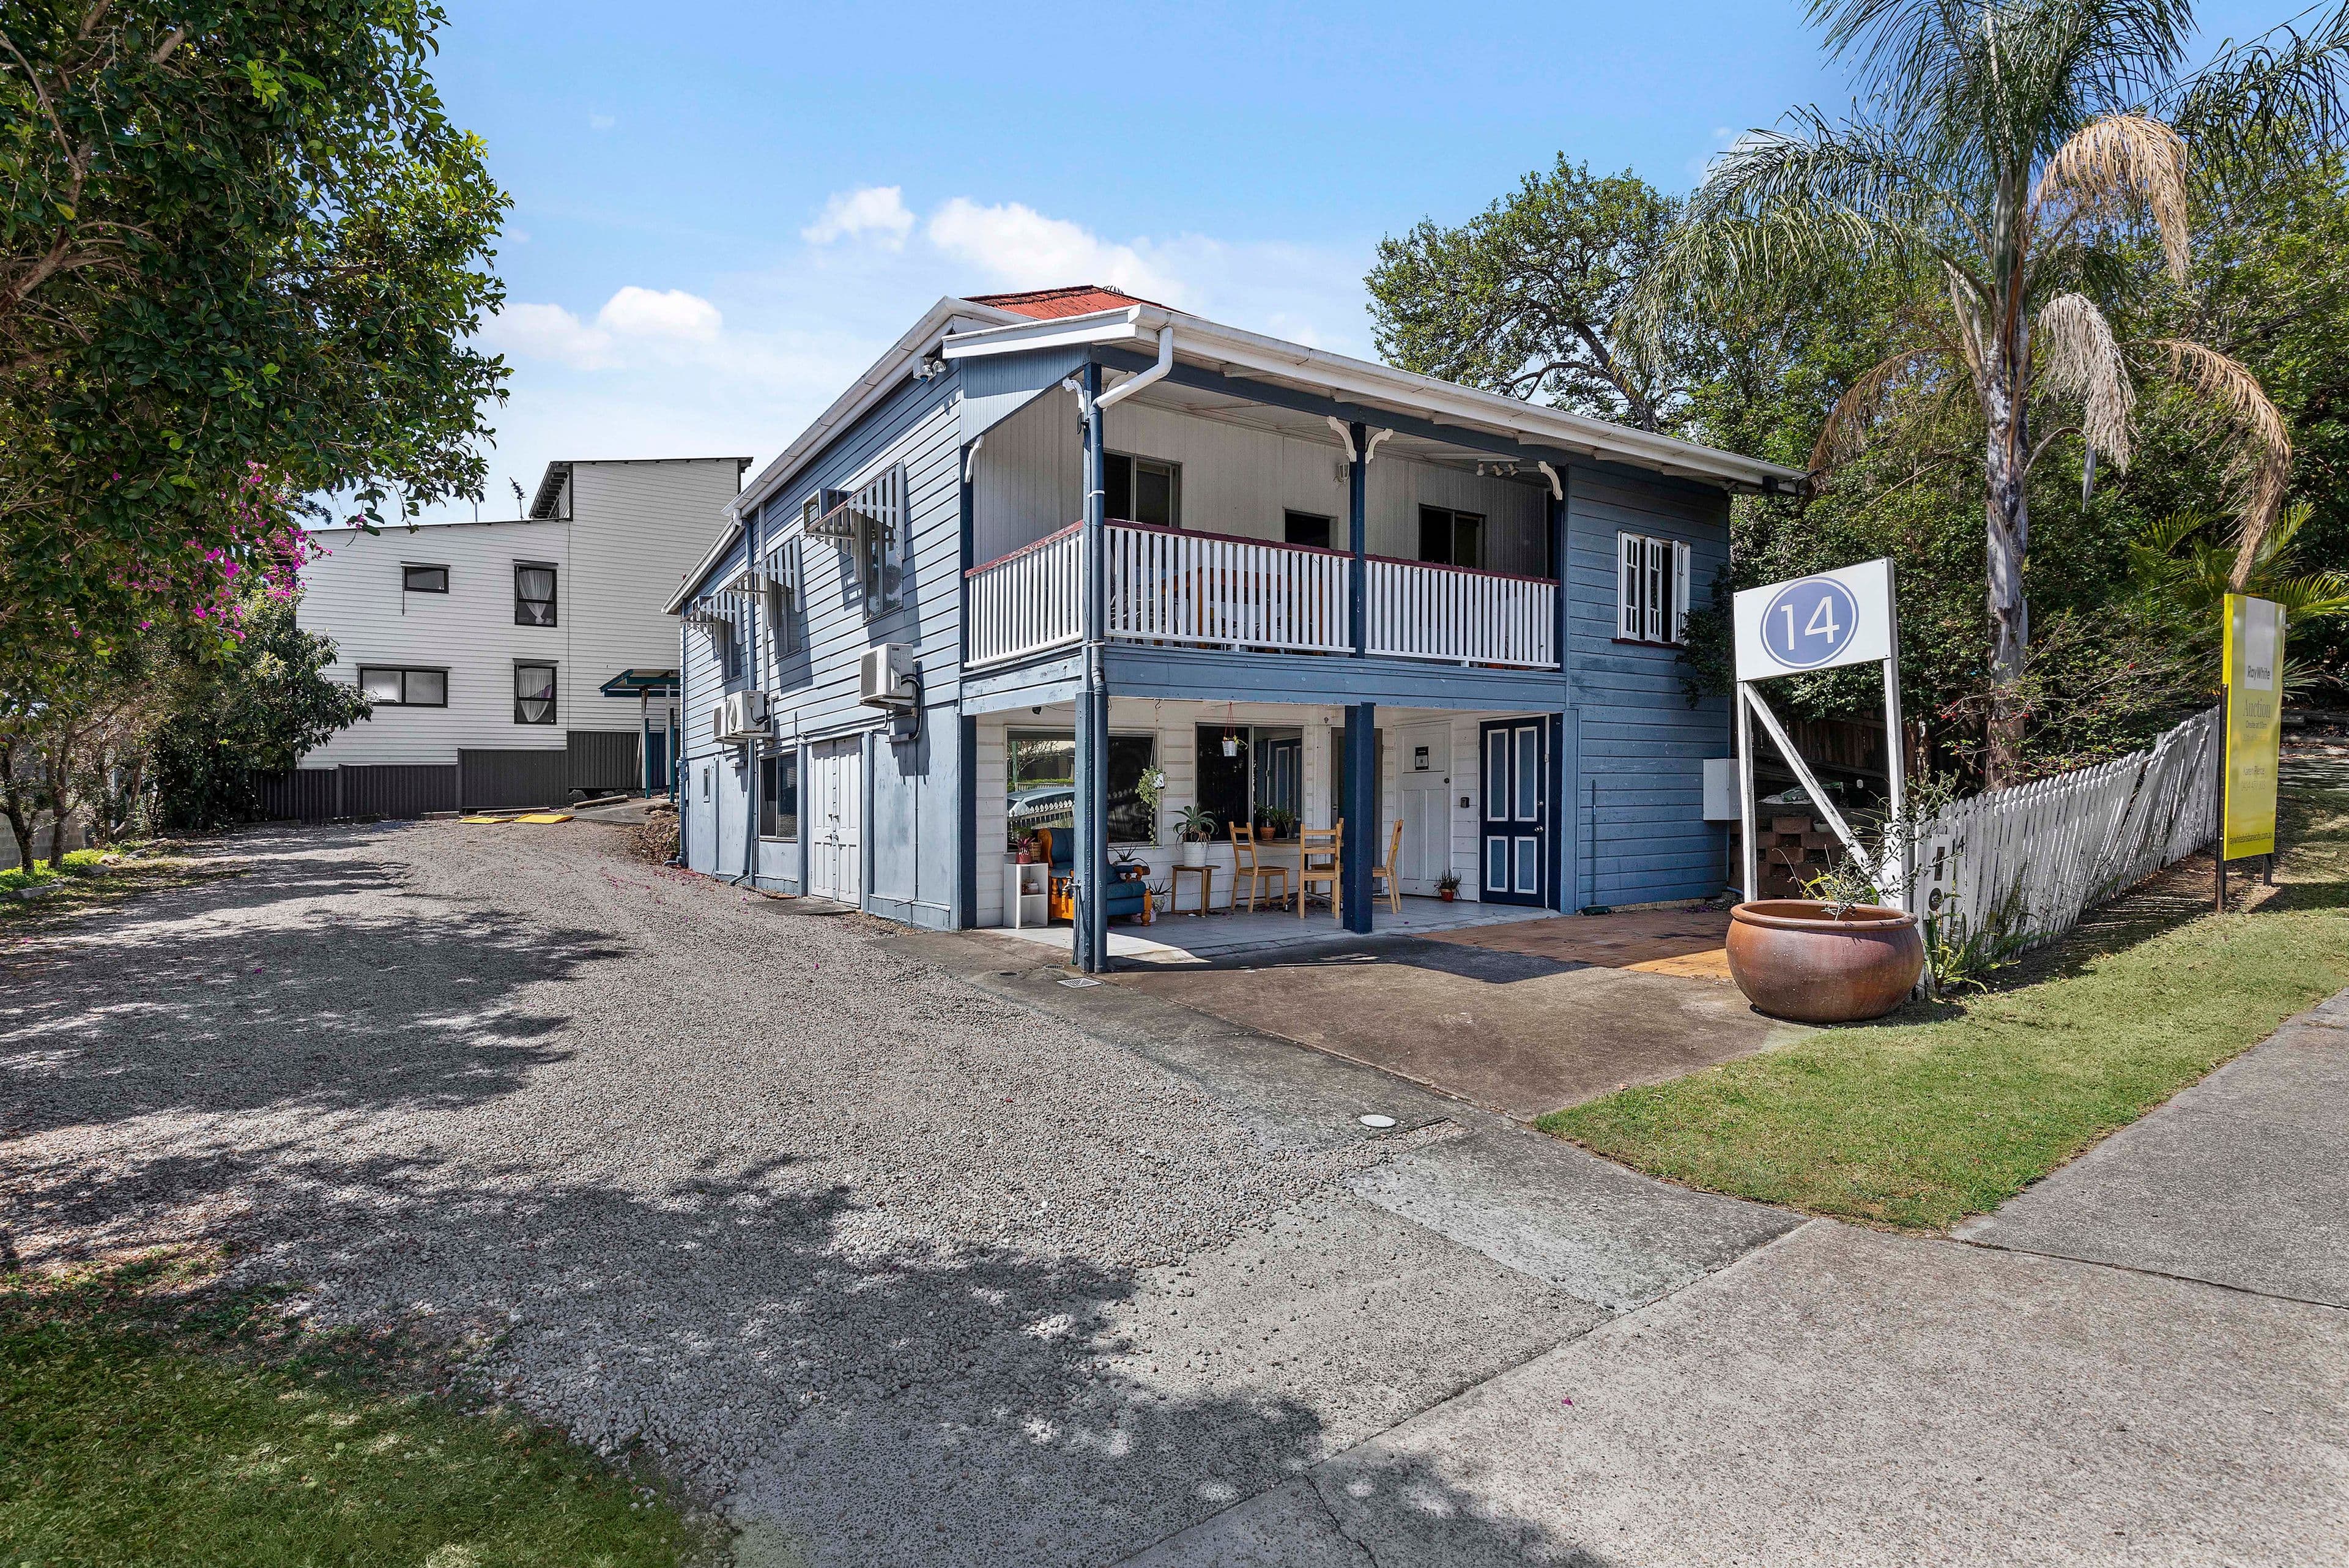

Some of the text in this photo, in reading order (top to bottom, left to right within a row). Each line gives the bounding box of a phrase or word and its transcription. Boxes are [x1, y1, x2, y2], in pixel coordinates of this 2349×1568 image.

[1781, 596, 1840, 651] 14
[2243, 698, 2271, 718] Auction
[1951, 835, 1965, 855] 14
